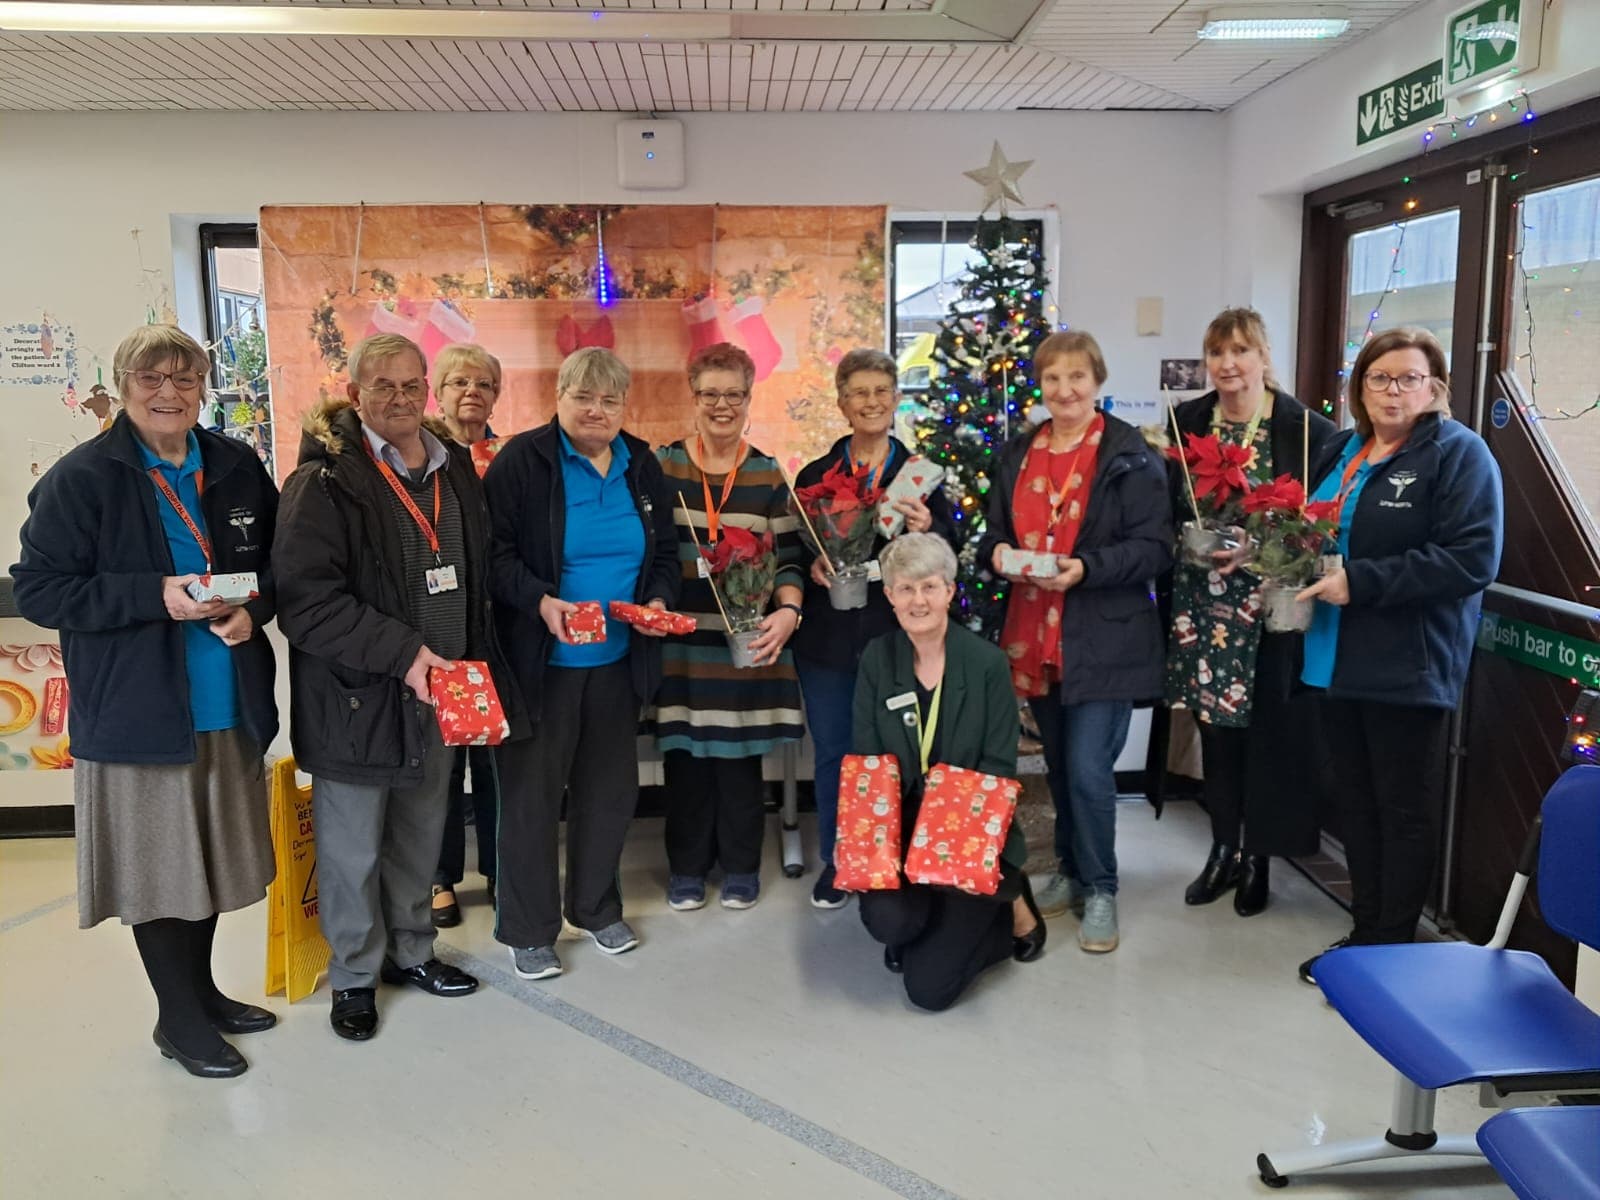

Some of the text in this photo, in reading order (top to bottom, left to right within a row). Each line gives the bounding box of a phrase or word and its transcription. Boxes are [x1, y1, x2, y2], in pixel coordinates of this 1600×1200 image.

[1410, 74, 1444, 112] Exit
[163, 485, 184, 516] HOSPITAL
[1482, 618, 1520, 648] Push
[1524, 630, 1553, 658] bar
[1558, 640, 1577, 667] to
